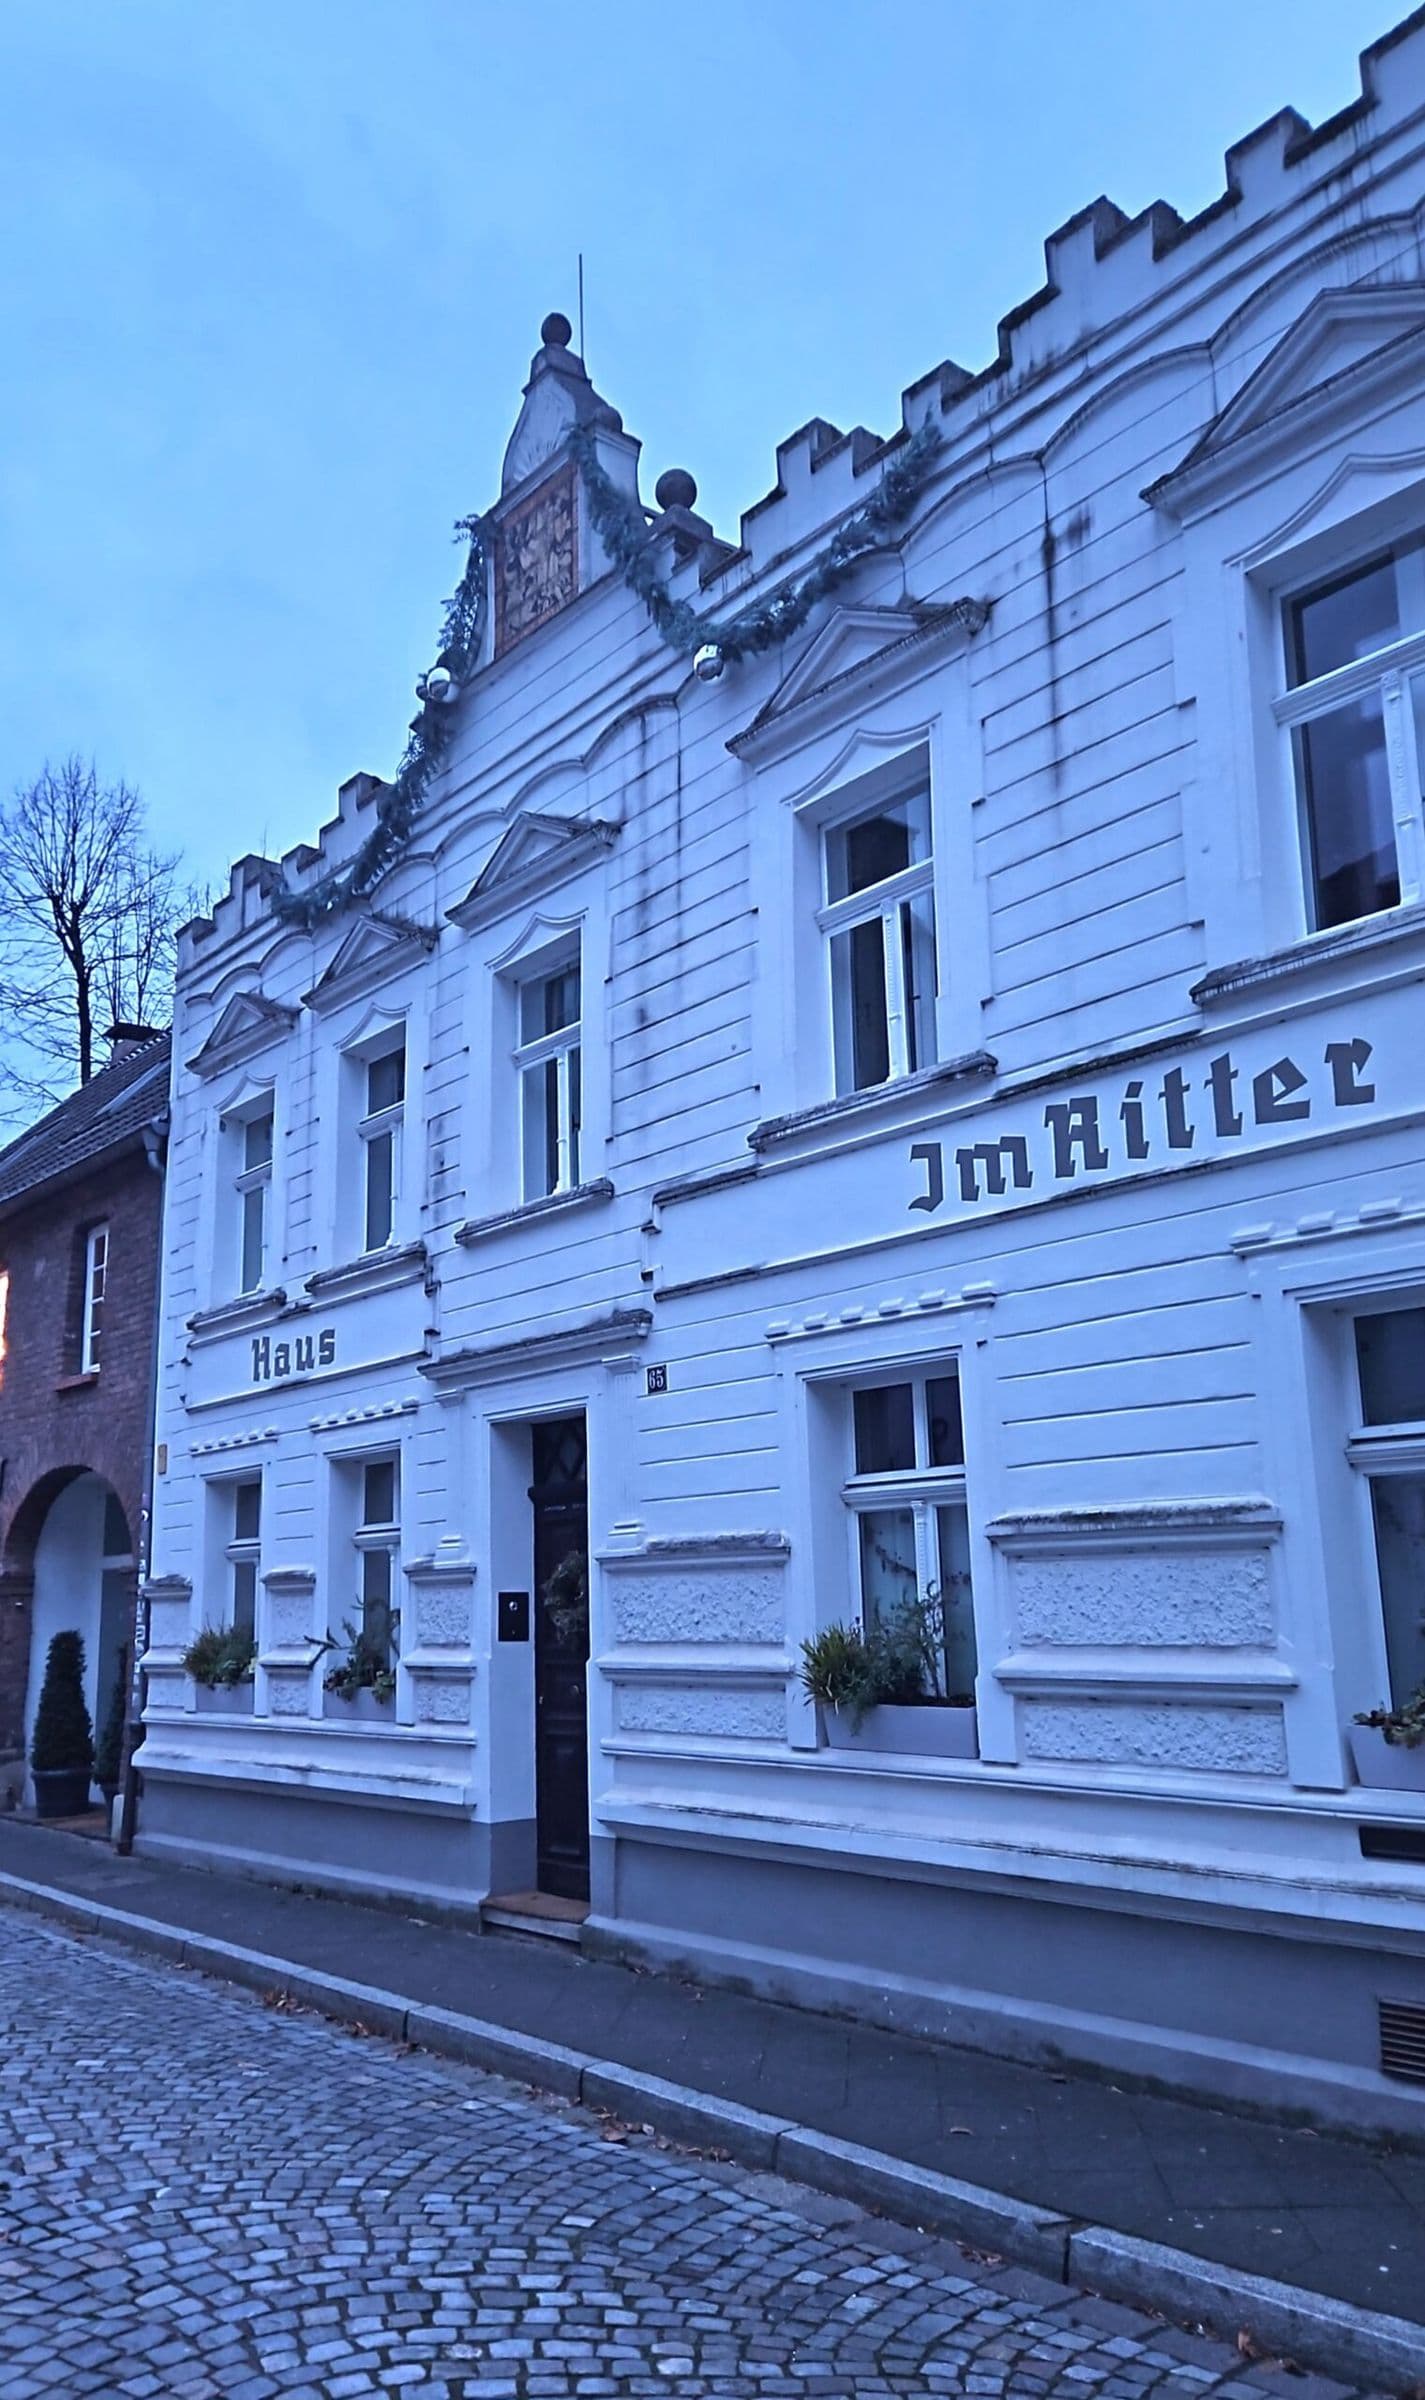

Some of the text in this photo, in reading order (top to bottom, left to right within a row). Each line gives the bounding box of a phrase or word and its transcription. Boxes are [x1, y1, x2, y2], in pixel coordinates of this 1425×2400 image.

[1044, 1038, 1376, 1178] Ritter
[251, 1329, 335, 1382] Haus
[648, 1369, 664, 1389] 65
